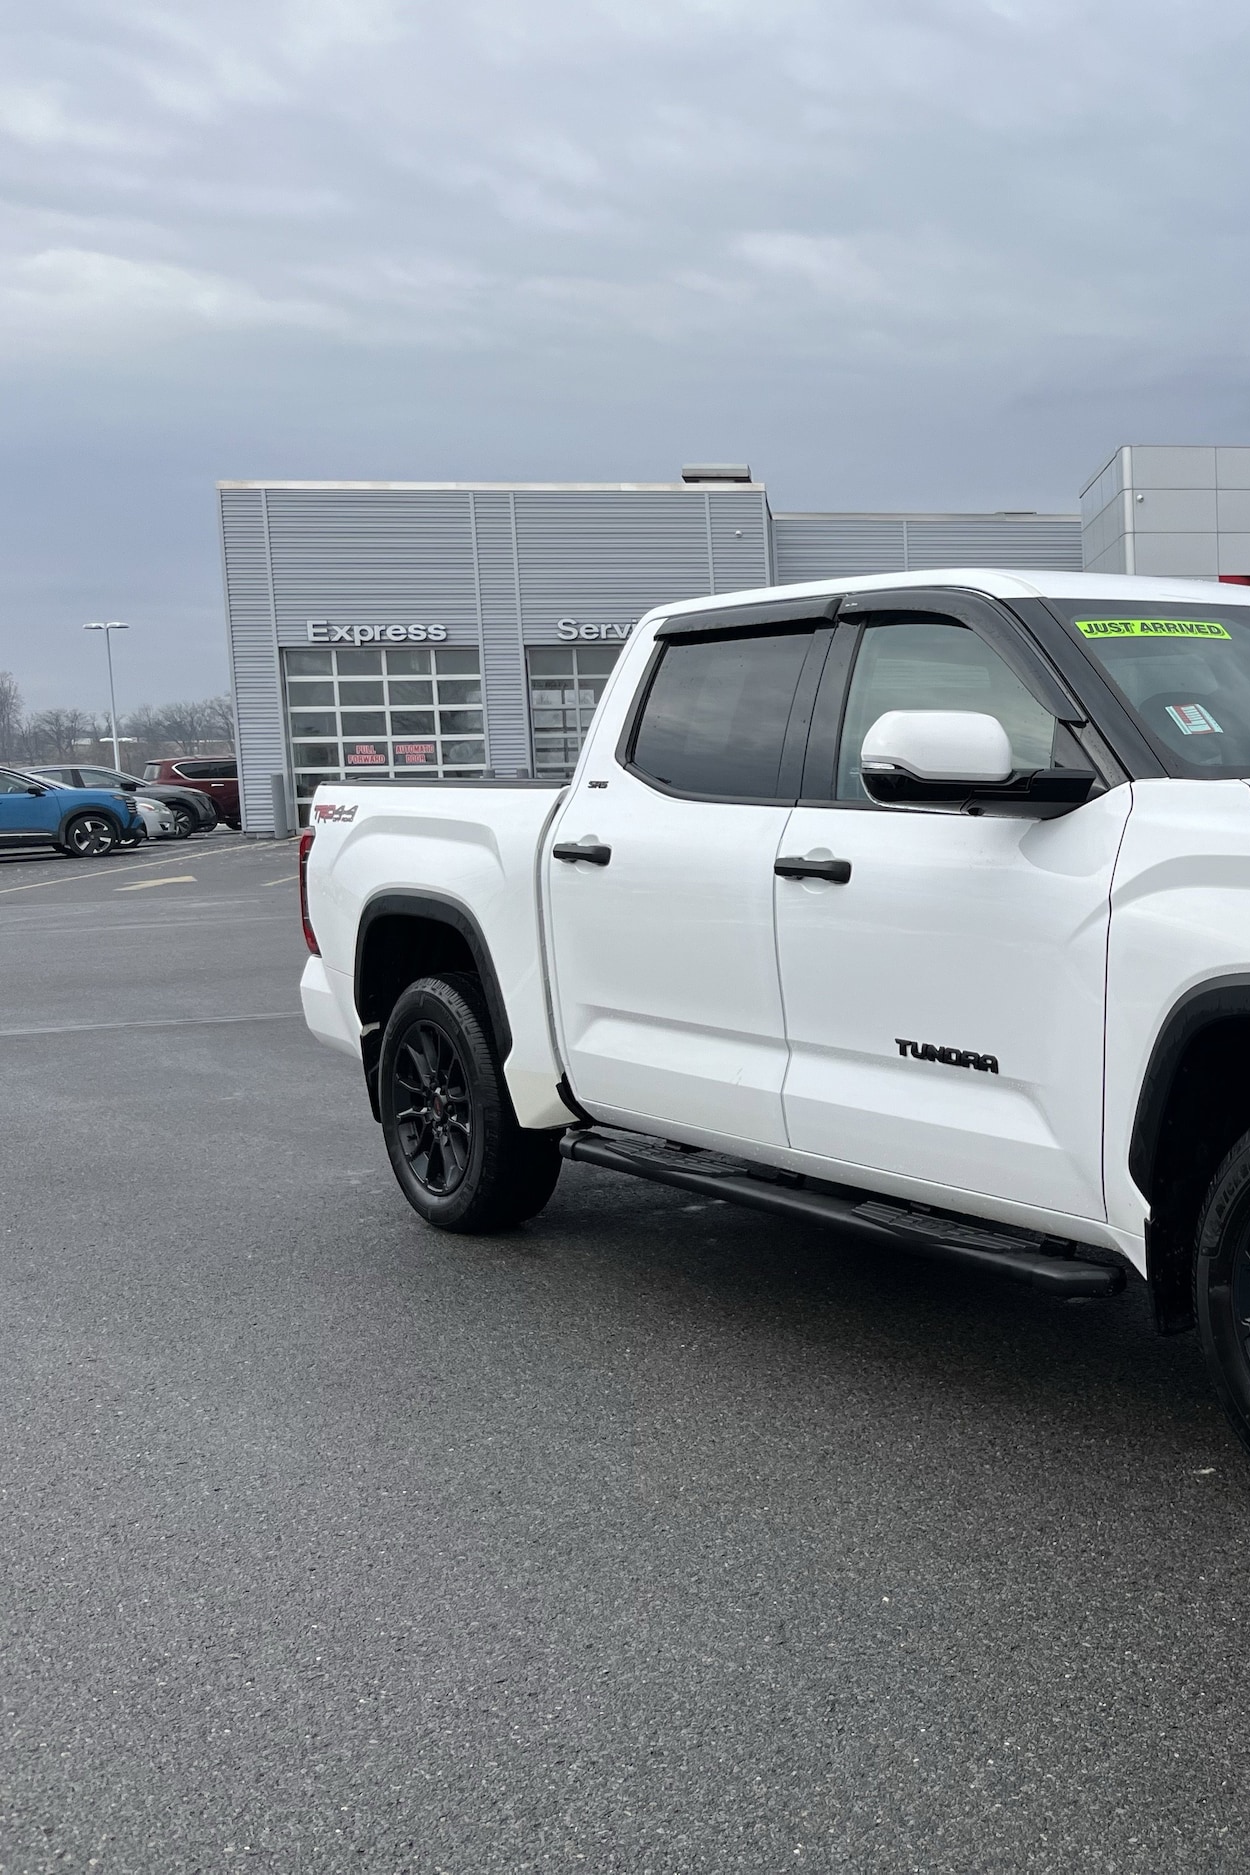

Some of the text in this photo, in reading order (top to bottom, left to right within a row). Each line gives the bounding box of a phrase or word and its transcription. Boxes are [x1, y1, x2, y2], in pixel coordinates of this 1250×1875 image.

[306, 619, 448, 647] Express
[1083, 622, 1225, 636] JUST ARRIVED
[355, 744, 377, 755] PULL
[395, 744, 435, 755] AUTOMATIC
[347, 754, 386, 765] FORWARD
[405, 754, 427, 764] DOOR
[894, 1038, 999, 1075] TUNDRA
